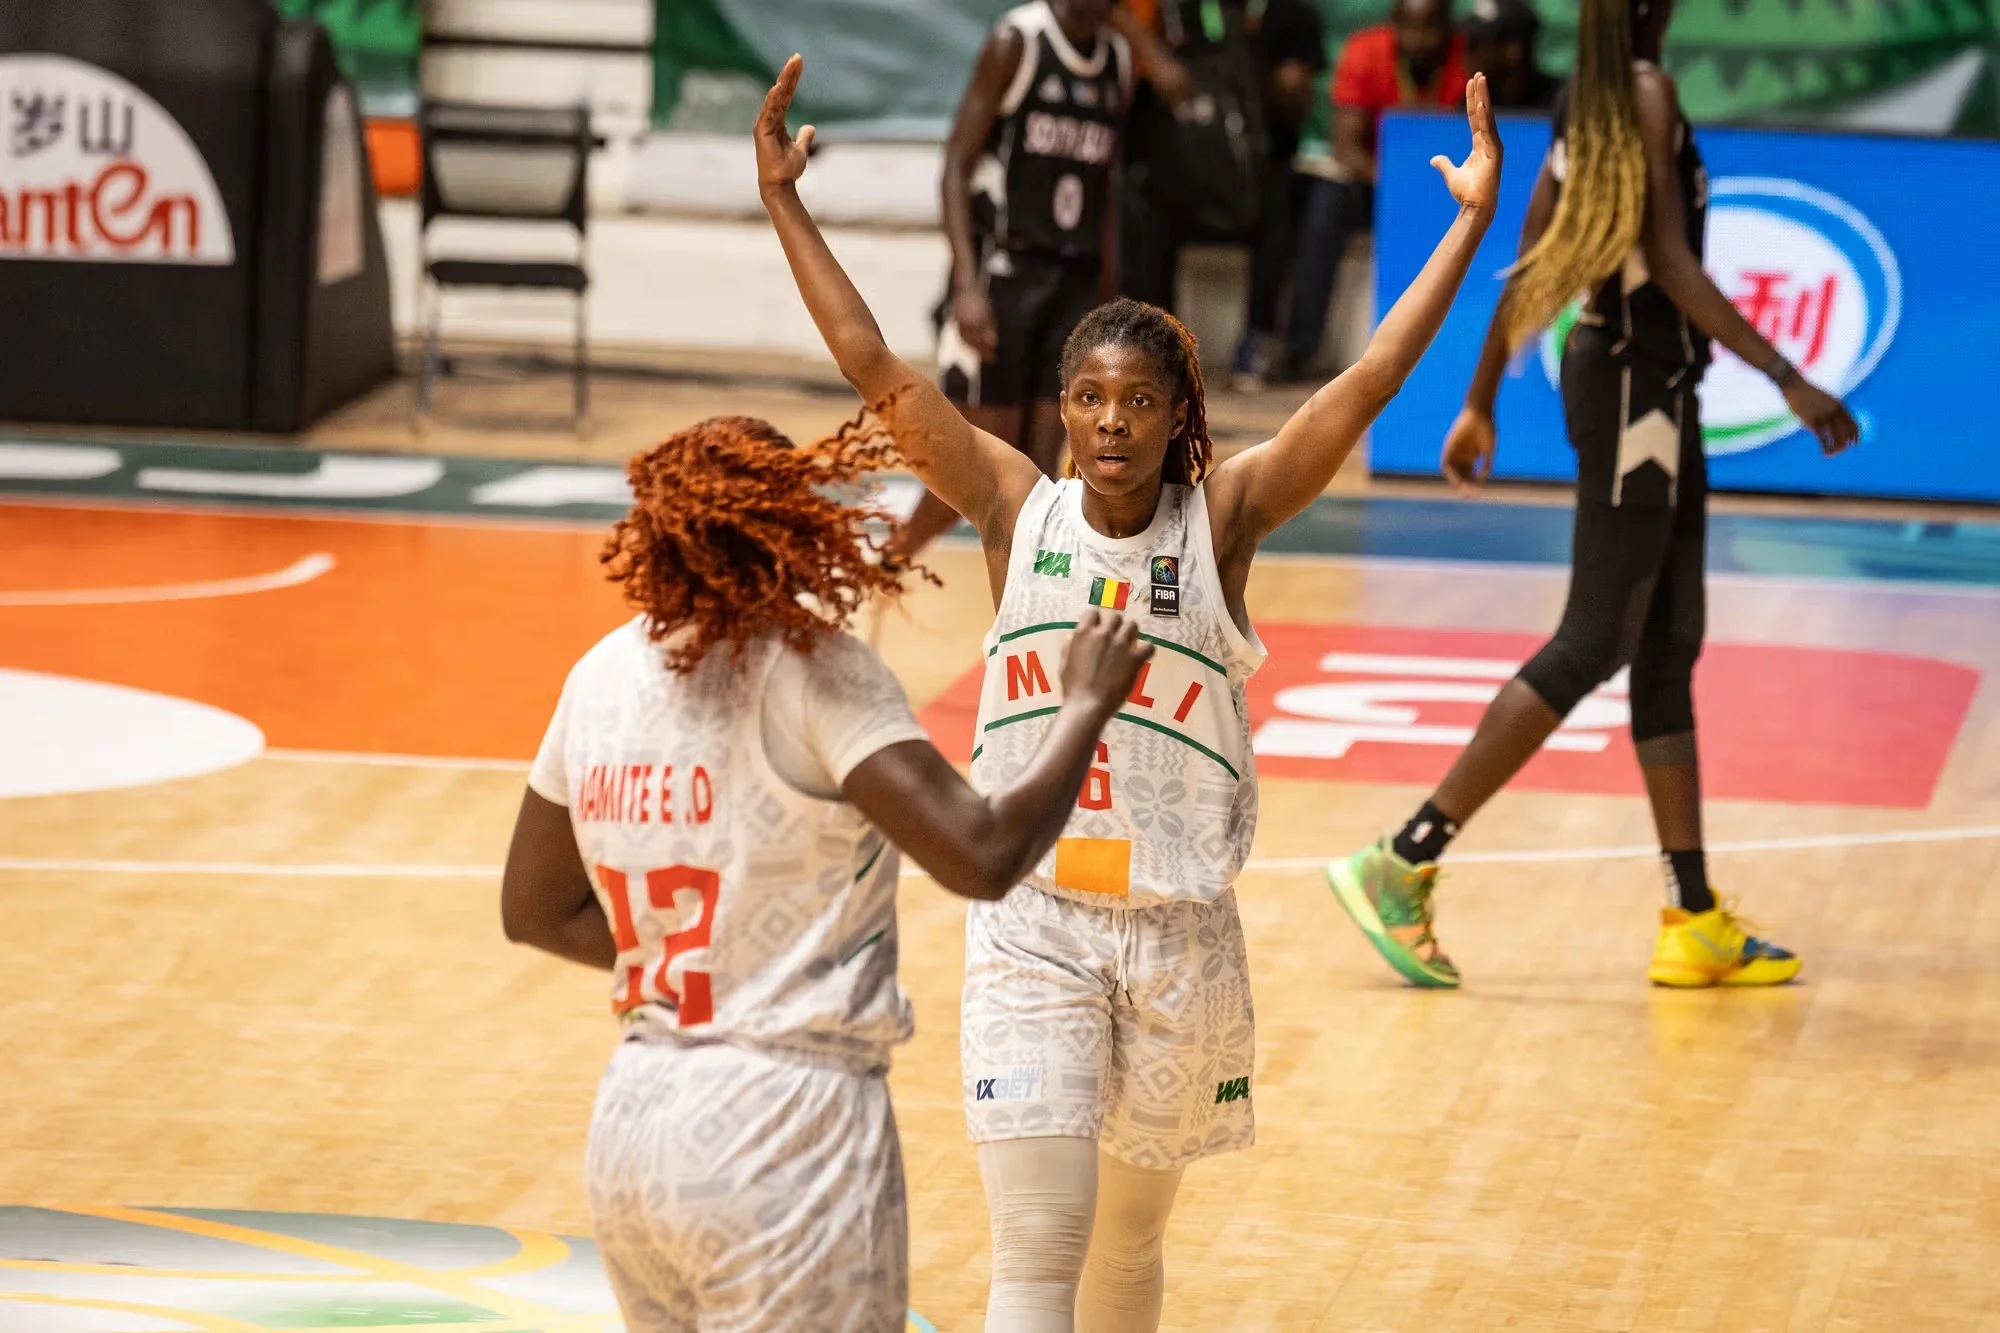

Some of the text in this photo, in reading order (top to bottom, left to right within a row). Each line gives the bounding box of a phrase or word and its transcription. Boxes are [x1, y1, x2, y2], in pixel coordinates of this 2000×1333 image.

[1052, 173, 1084, 231] 0
[1710, 268, 1838, 374] 利
[1033, 549, 1073, 578] WA
[1154, 588, 1176, 601] FIBA
[1006, 650, 1203, 723] MLI
[595, 864, 720, 1027] 12
[1215, 1076, 1249, 1104] WA
